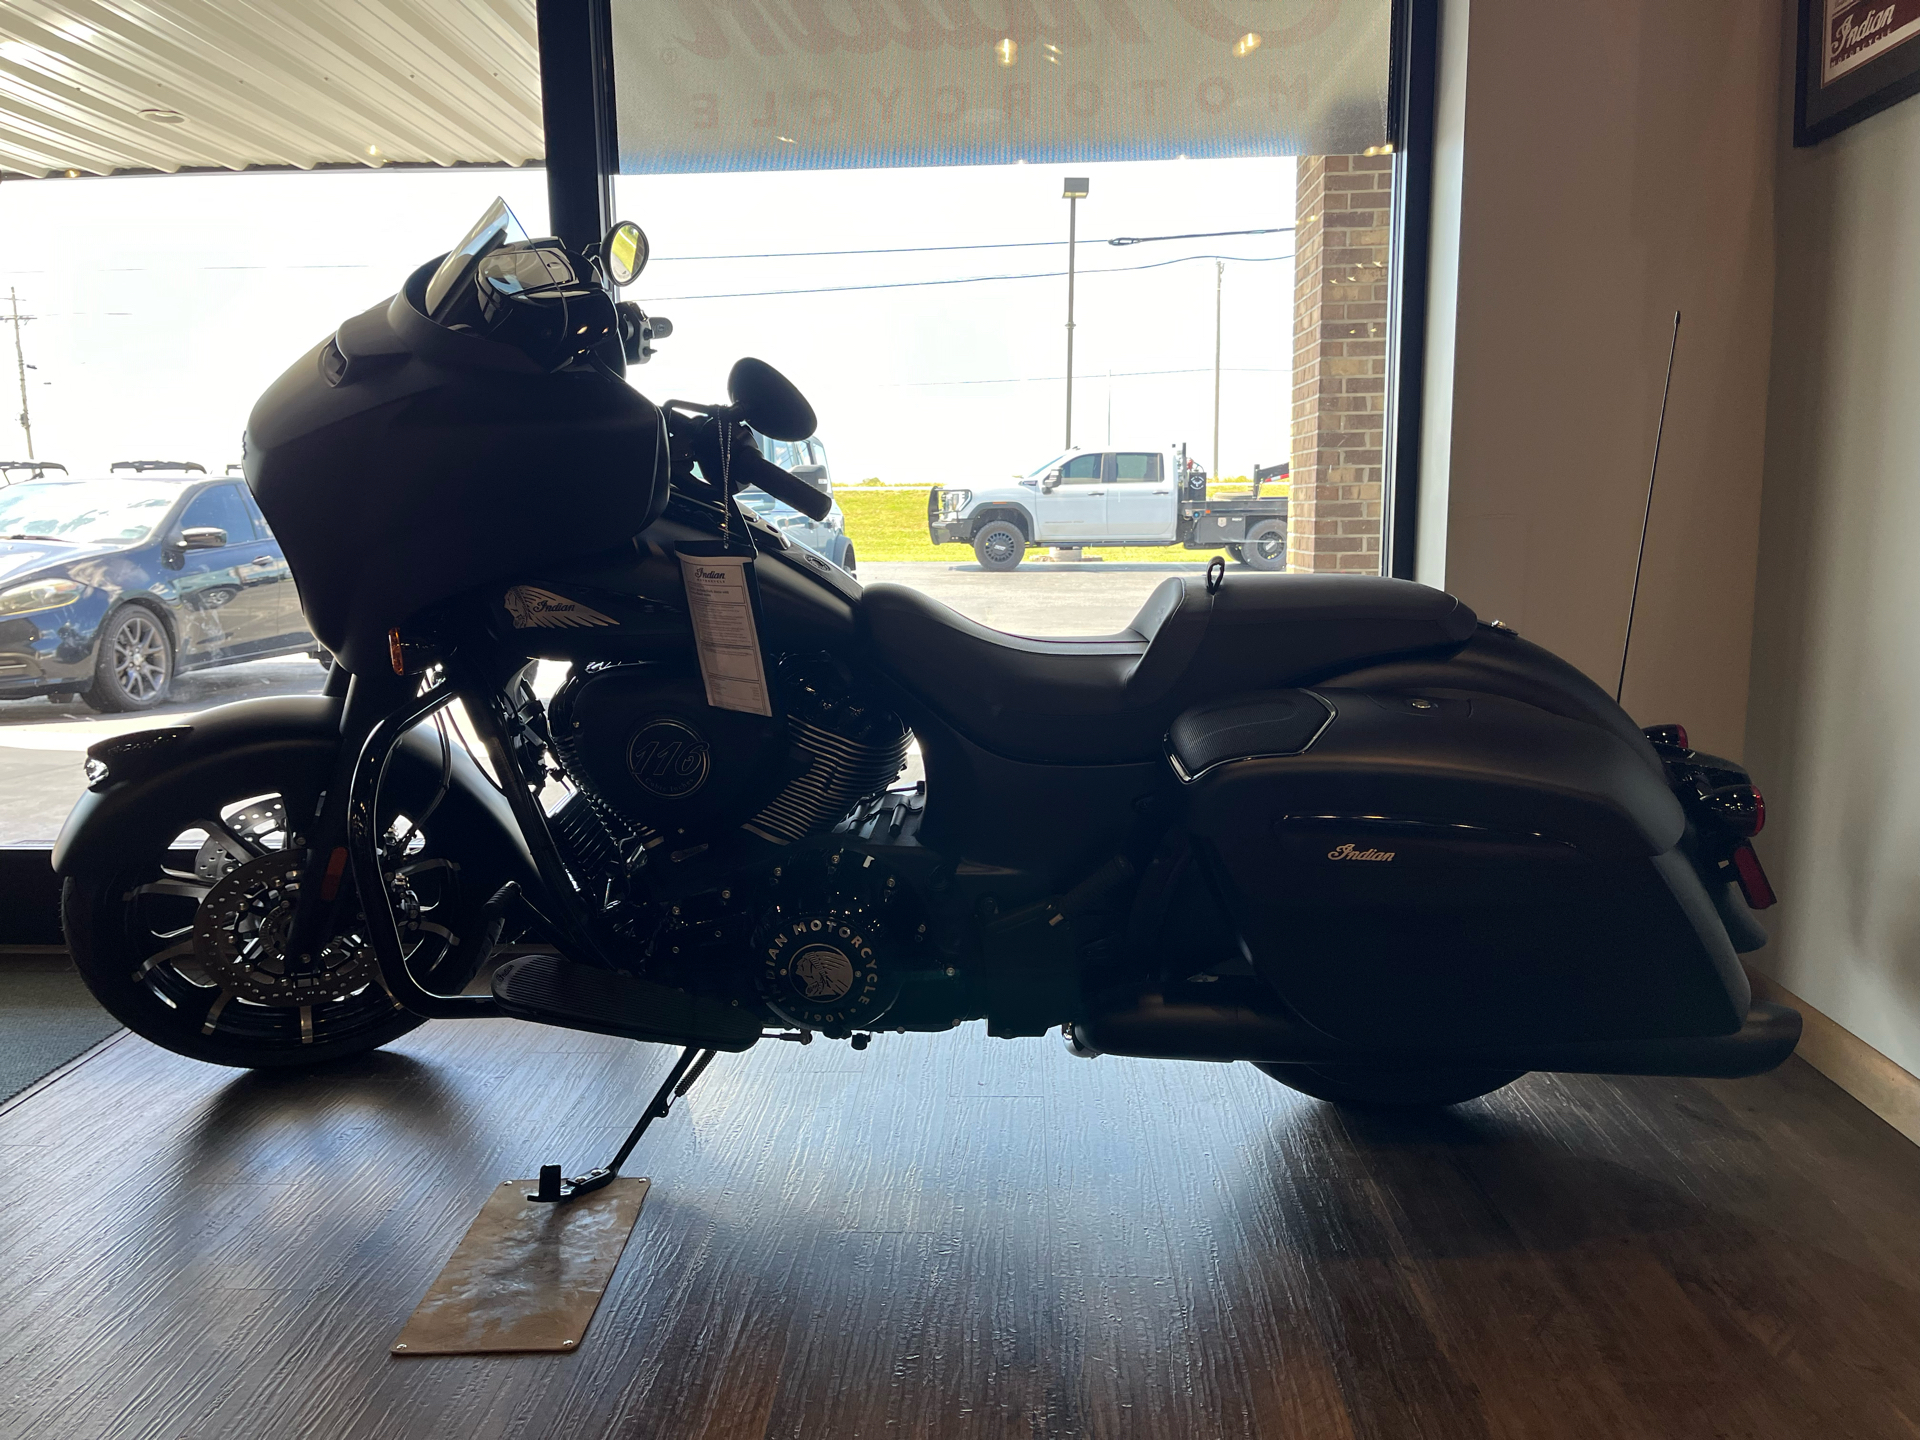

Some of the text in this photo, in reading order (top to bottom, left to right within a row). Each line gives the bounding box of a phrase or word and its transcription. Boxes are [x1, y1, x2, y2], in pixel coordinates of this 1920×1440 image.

[1831, 4, 1896, 58] Indian
[694, 567, 726, 579] Indian
[533, 600, 575, 612] Indian
[632, 741, 710, 776] 116
[1328, 843, 1396, 862] Indian
[792, 919, 878, 1006] MOTORCYCLE
